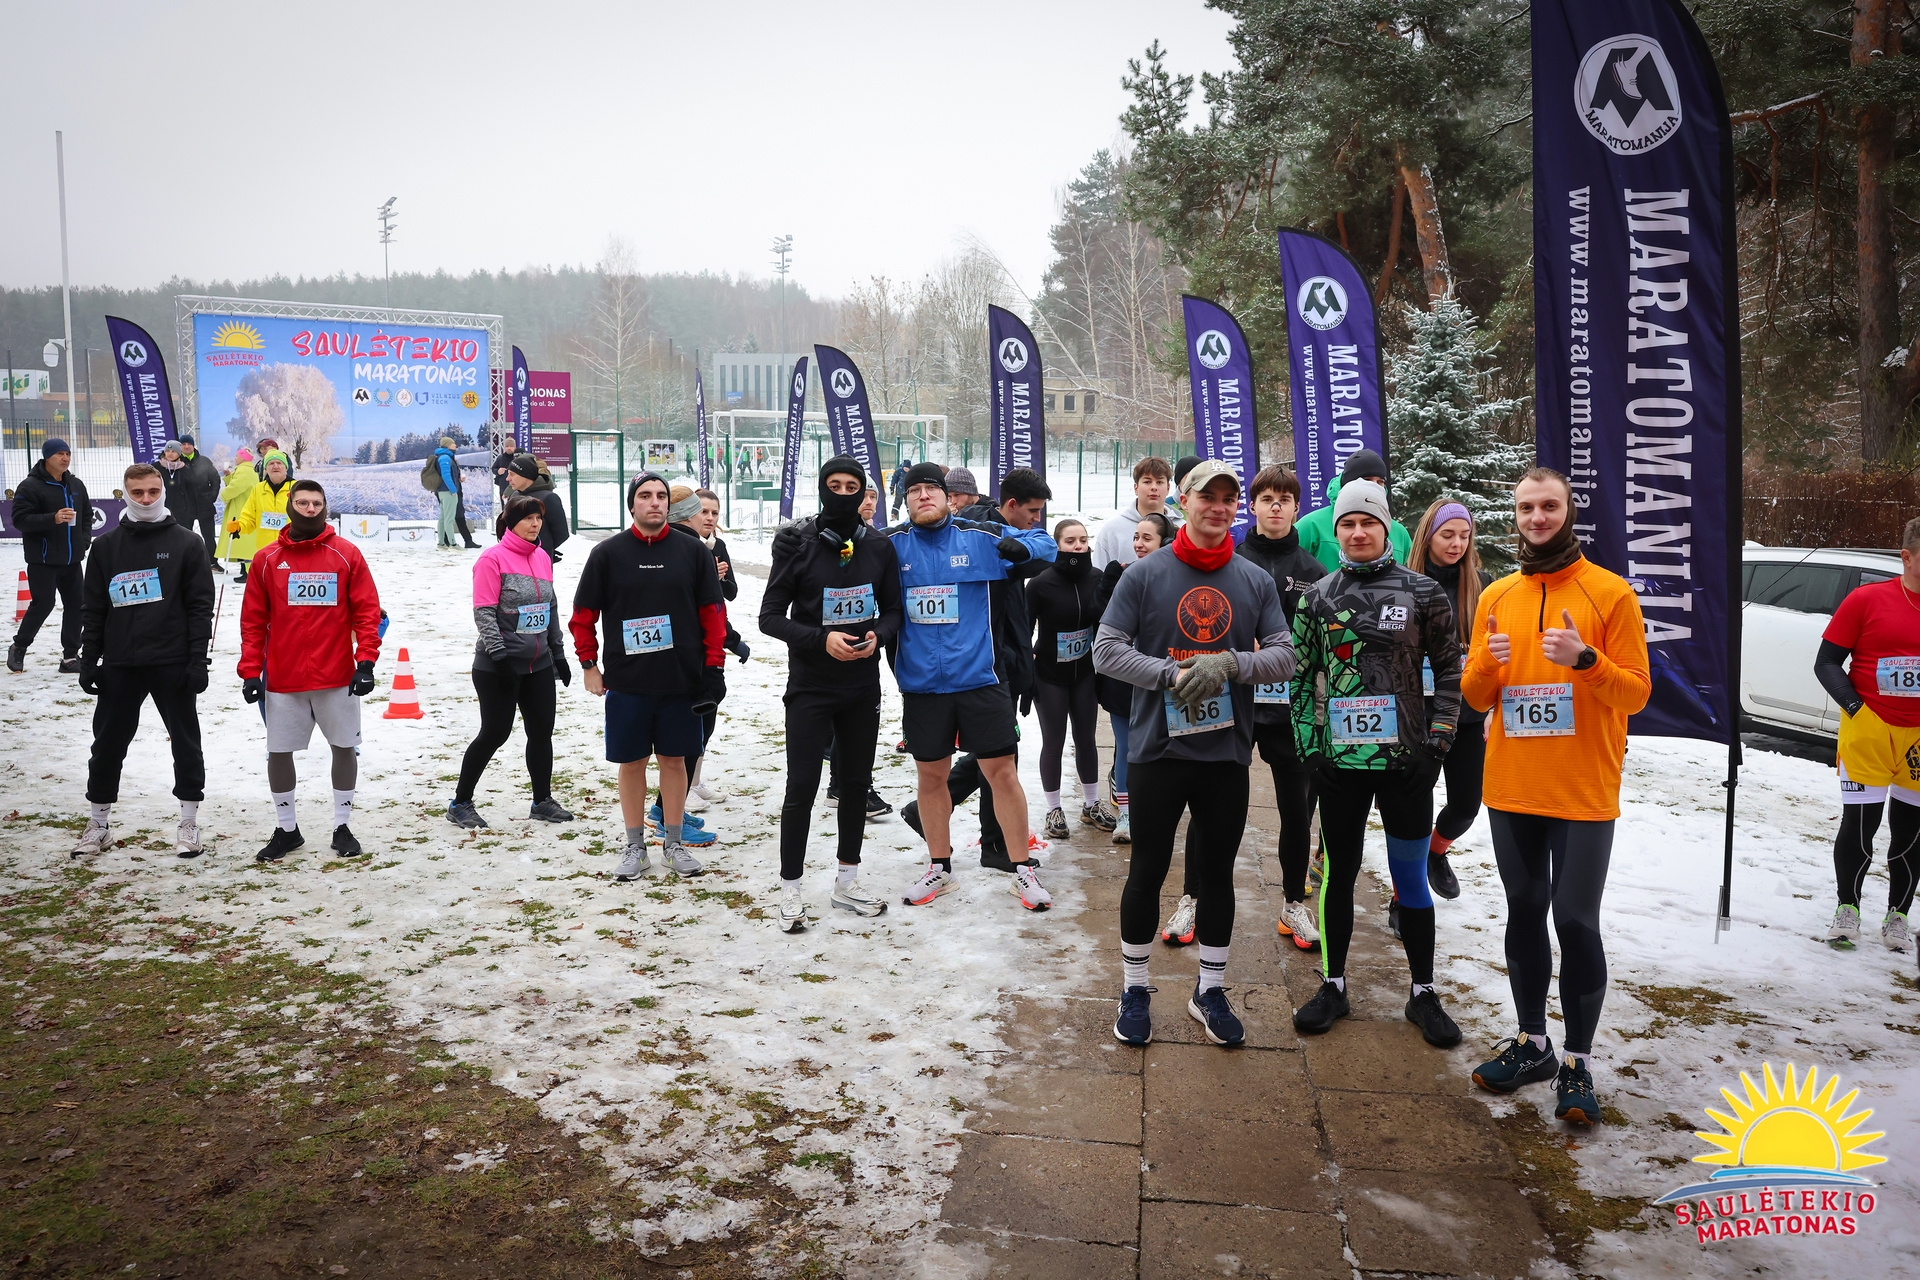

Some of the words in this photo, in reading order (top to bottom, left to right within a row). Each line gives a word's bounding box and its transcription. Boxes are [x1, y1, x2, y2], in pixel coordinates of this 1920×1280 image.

[1584, 109, 1679, 152] MARATOMANIJA
[291, 329, 479, 363] SAULĖTEKIO
[1567, 186, 1598, 545] www.maratomanijalt
[354, 363, 477, 386] MARATONAS
[39, 375, 48, 392] iki
[507, 387, 566, 398] SDIONAS
[1623, 188, 1694, 643] MARATOMANIJA
[1303, 344, 1322, 507] www.maratomanija.lt
[1210, 460, 1226, 472] LA
[265, 518, 281, 526] 430
[358, 520, 367, 534] 1
[409, 531, 416, 539] 3
[119, 582, 148, 598] 141
[297, 584, 327, 598] 200
[833, 599, 865, 616] 413
[917, 599, 946, 615] 101
[526, 614, 545, 628] 239
[632, 629, 662, 646] 134
[1066, 639, 1088, 655] 107
[1515, 703, 1558, 724] 165
[1343, 713, 1383, 733] 152
